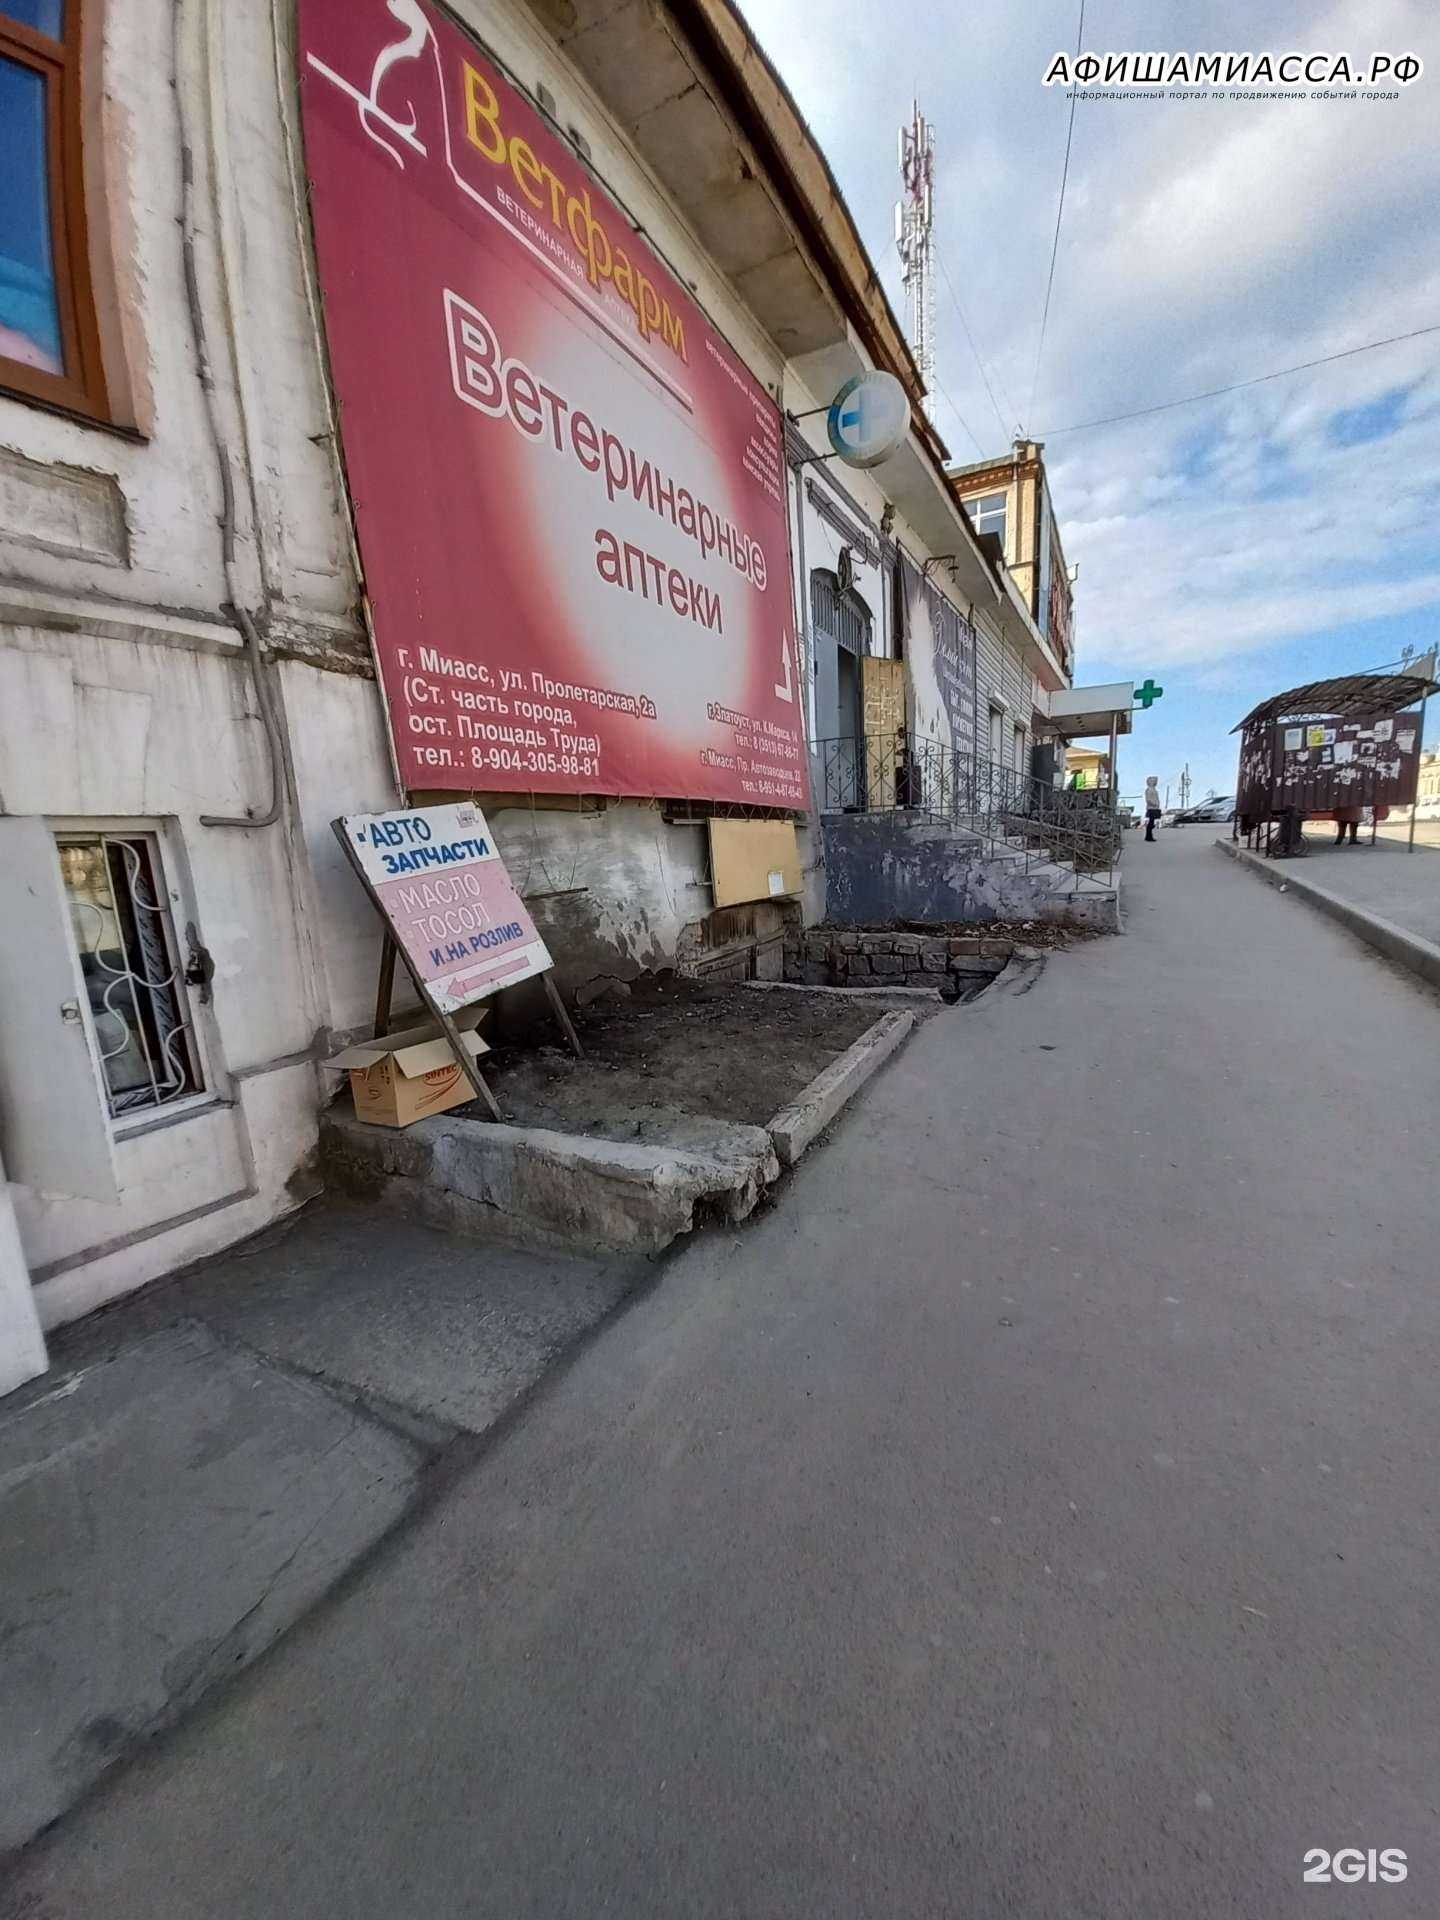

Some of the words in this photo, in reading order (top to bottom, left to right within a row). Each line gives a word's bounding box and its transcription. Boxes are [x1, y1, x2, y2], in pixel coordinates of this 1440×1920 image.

[461, 56, 689, 363] Ветфарм
[495, 184, 585, 280] ВЕТЕРИНАРНАЯ
[443, 288, 767, 591] Ветеринарные
[594, 528, 724, 635] аптеки
[397, 648, 414, 670] г.
[419, 646, 496, 688] Миасс,
[500, 669, 528, 692] ул.
[531, 671, 641, 718] Пролетарская,
[403, 676, 445, 708] (Ст.
[450, 689, 510, 714] часть
[514, 700, 577, 728] города,
[408, 714, 452, 737] ост.
[456, 714, 548, 751] Площадь
[549, 727, 602, 758] Труда)
[412, 745, 466, 769] тел.:
[470, 746, 601, 777] 8-904-305-98-81
[368, 816, 432, 849] АВТО
[381, 838, 490, 875] ЗАПЧАСТИ
[398, 873, 481, 914] МАСЛО
[412, 902, 491, 944] ТОСОЛ
[446, 942, 471, 964] НА
[469, 921, 524, 952] РОЗЛИВ
